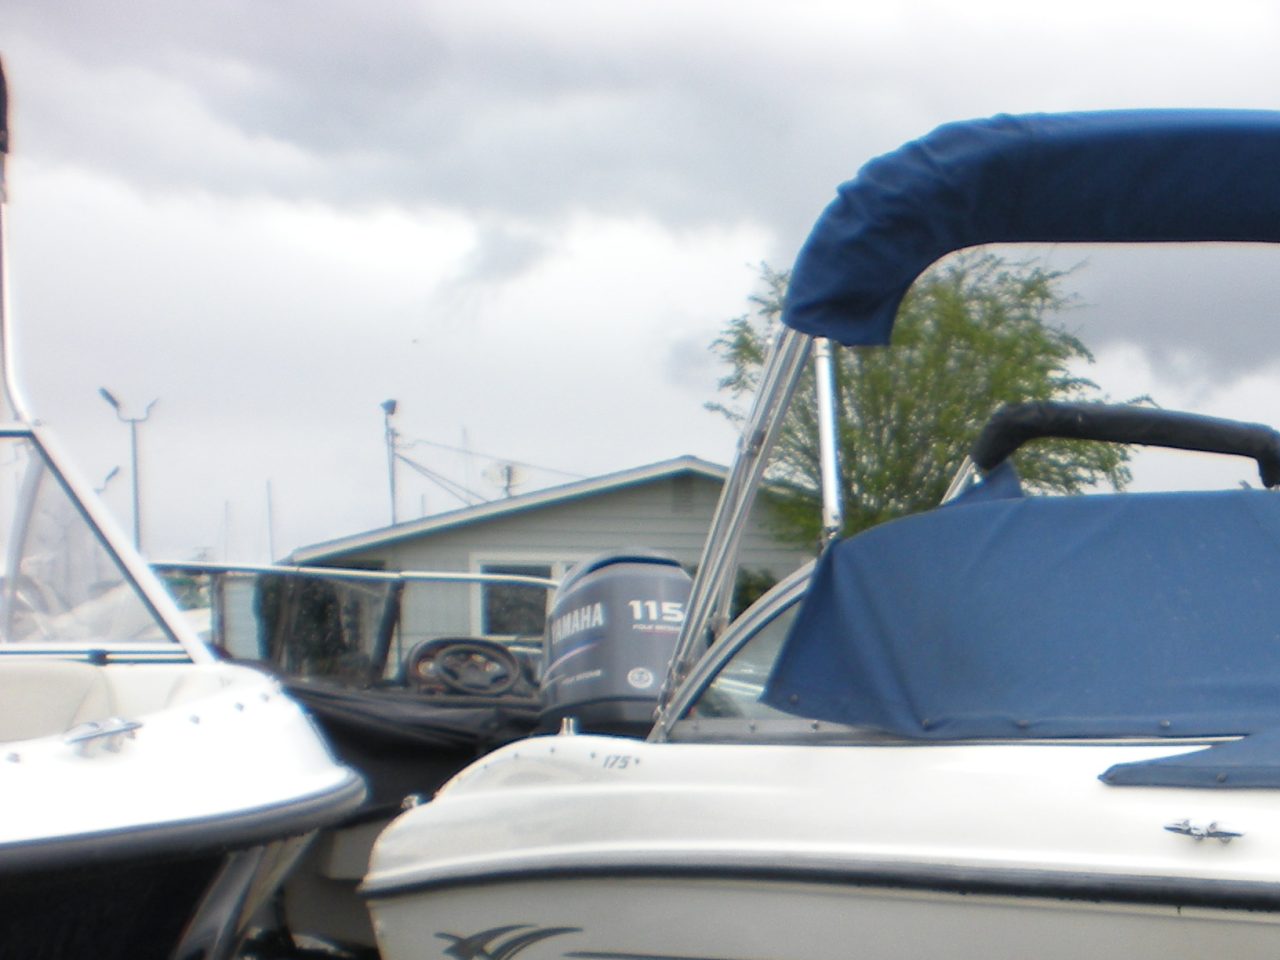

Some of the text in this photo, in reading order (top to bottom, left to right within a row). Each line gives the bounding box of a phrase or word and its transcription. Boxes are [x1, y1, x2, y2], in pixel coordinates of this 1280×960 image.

[628, 599, 684, 622] 115
[552, 602, 604, 644] YAMAHA
[603, 754, 632, 769] 175
